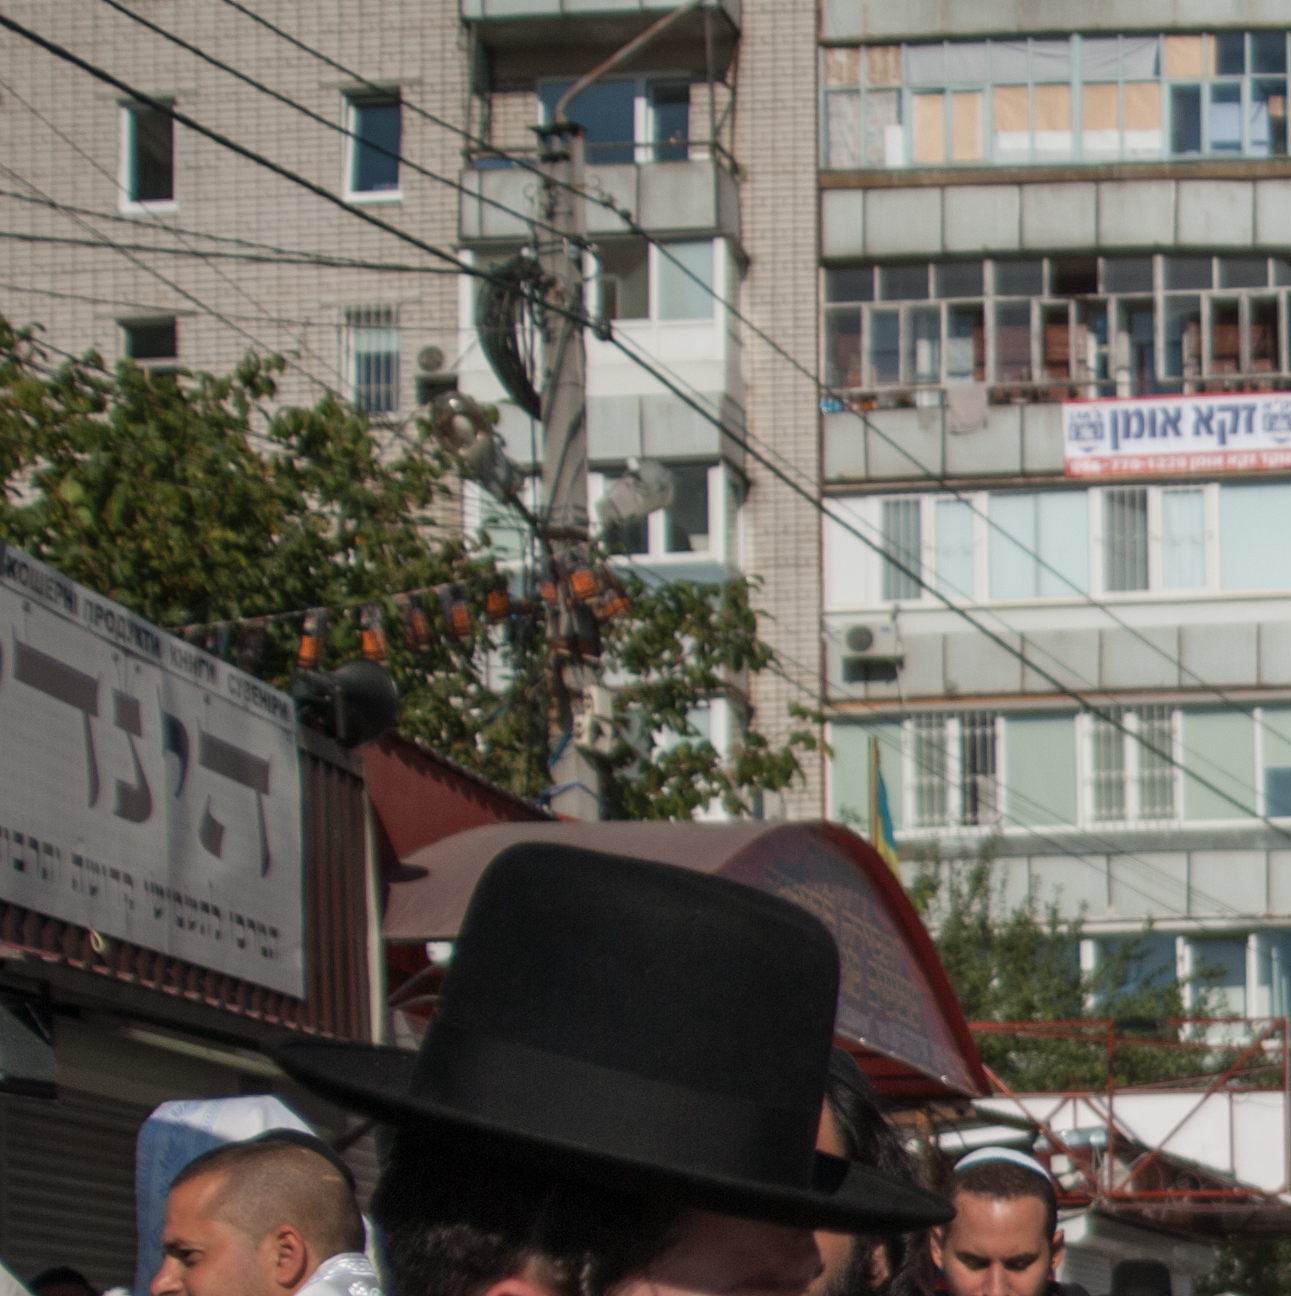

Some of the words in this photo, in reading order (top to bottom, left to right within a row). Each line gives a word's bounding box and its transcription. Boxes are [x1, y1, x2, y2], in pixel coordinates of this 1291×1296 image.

[1110, 406, 1183, 451] אומן
[1191, 403, 1257, 446] זקא
[4, 553, 79, 617] КОШЕРНІ
[83, 591, 162, 659] ПРОДУКТИ
[169, 641, 217, 683] КНИГИ
[227, 675, 290, 726] СУВЕНІРИ
[0, 636, 272, 879] הינד
[0, 824, 61, 879] ותרבו
